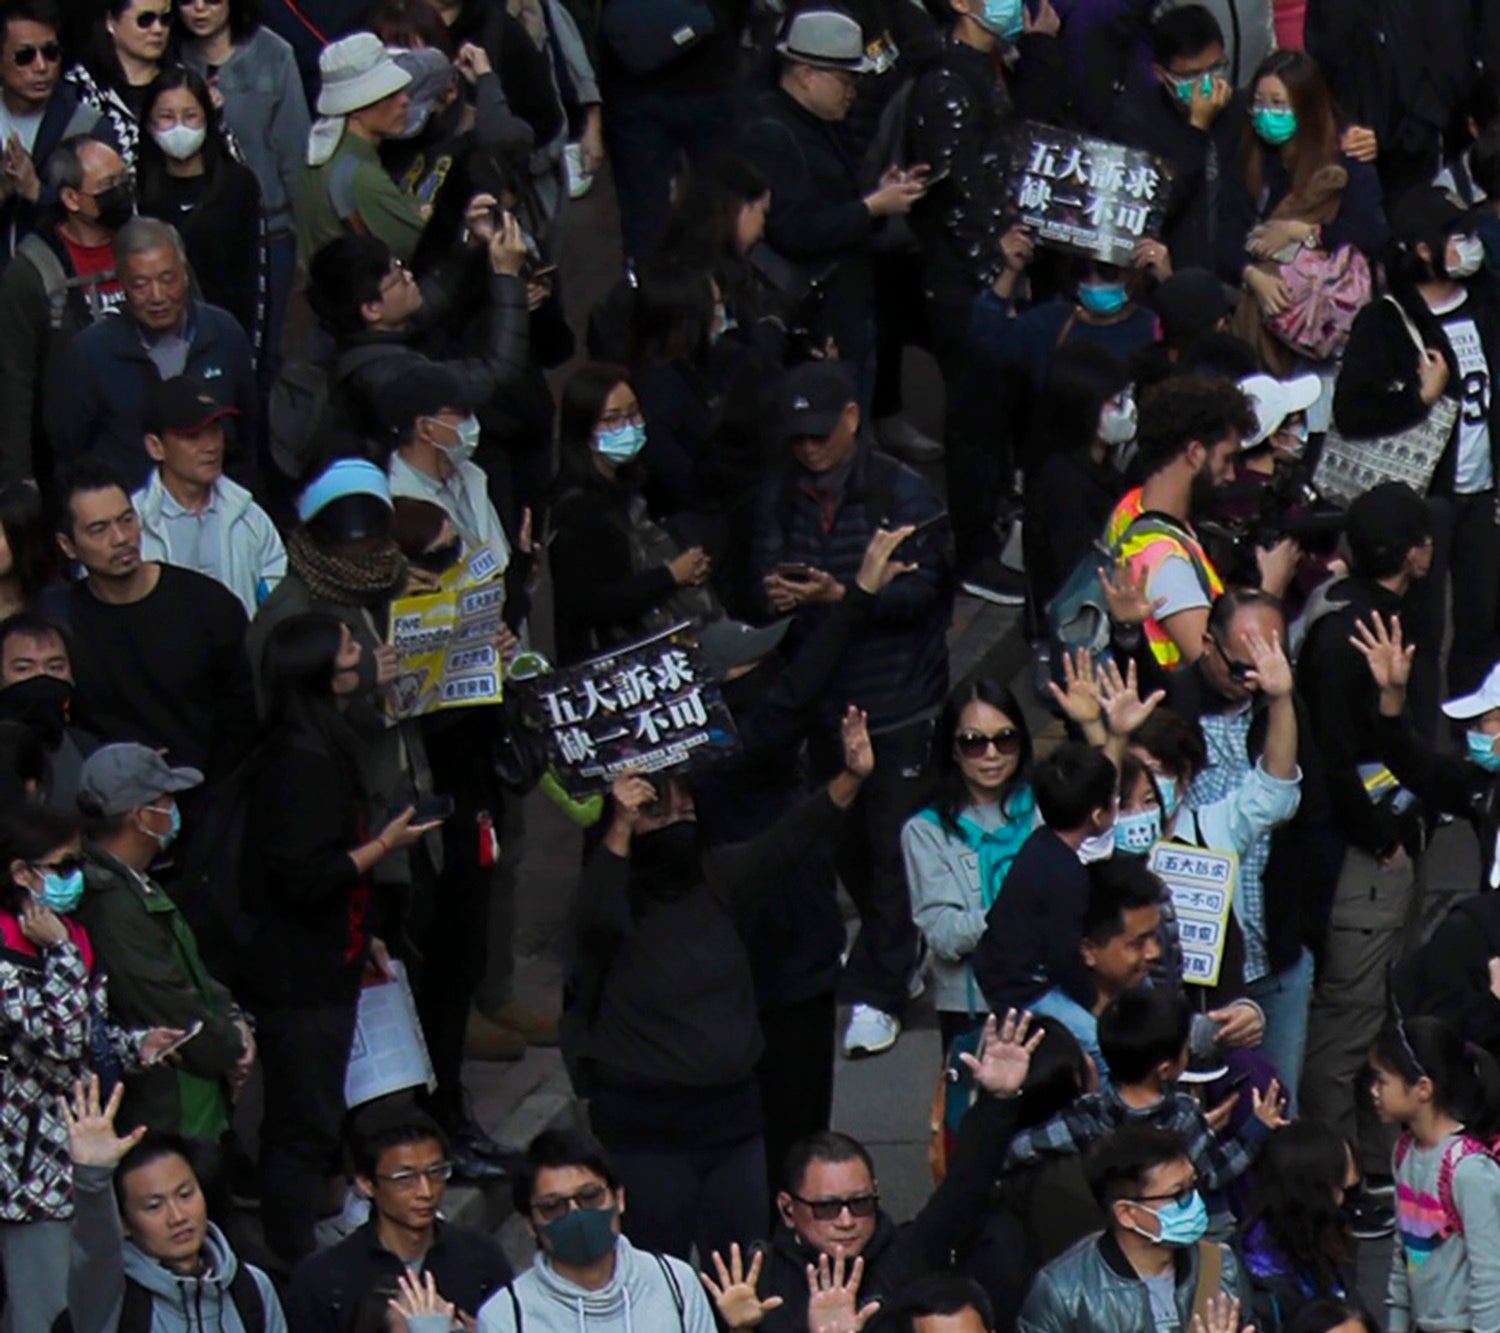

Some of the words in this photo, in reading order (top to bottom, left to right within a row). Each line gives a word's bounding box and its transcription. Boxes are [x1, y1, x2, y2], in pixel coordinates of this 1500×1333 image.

[538, 652, 701, 721] 五大訴求
[554, 689, 710, 765] 缺一不可
